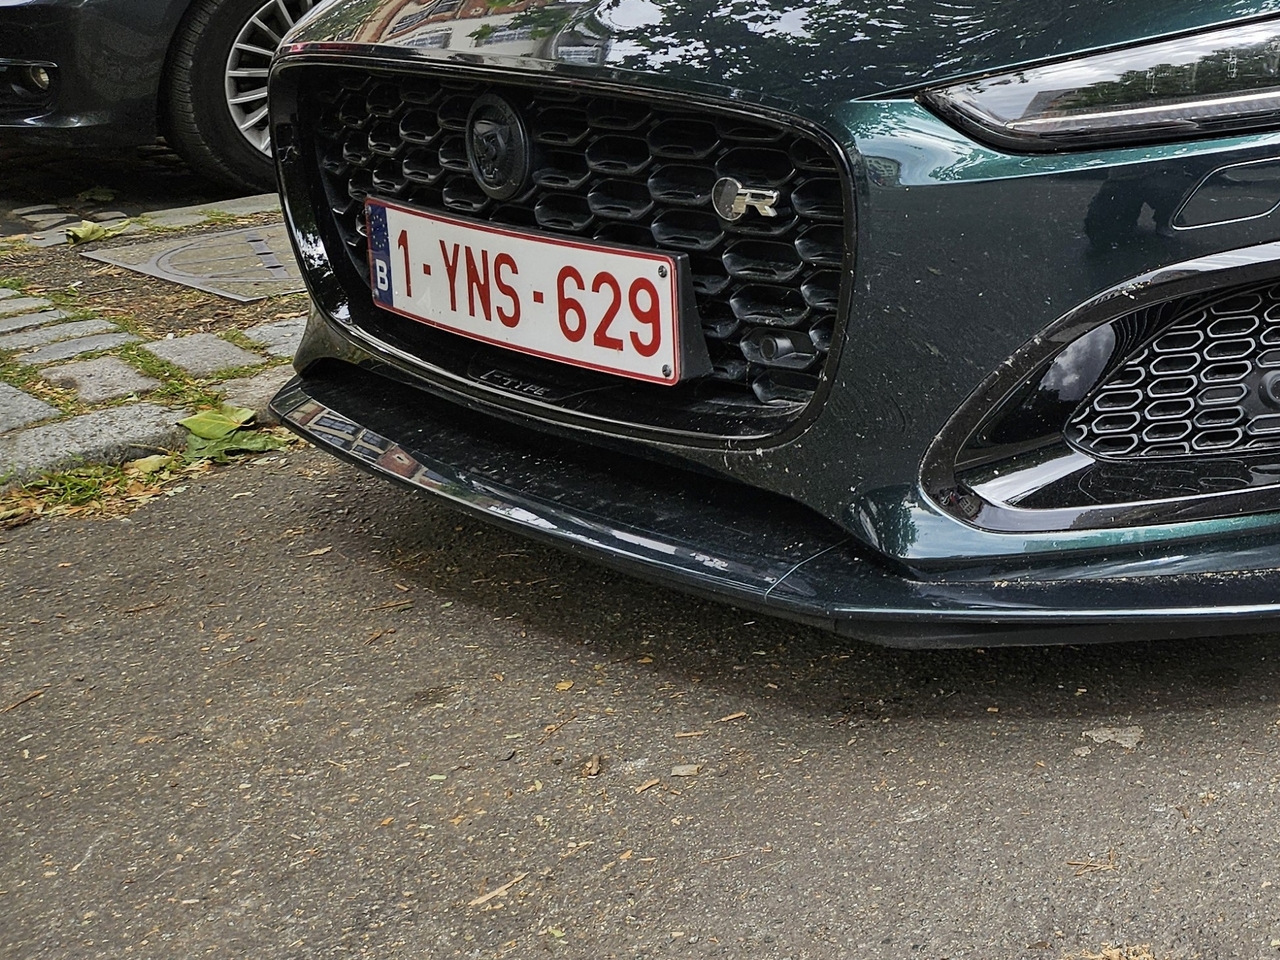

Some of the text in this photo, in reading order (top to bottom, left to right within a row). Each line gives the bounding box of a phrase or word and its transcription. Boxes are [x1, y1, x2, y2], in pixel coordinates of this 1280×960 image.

[375, 258, 389, 291] B
[397, 229, 662, 358] 1-YNS-629
[480, 369, 550, 395] F-TYPE
